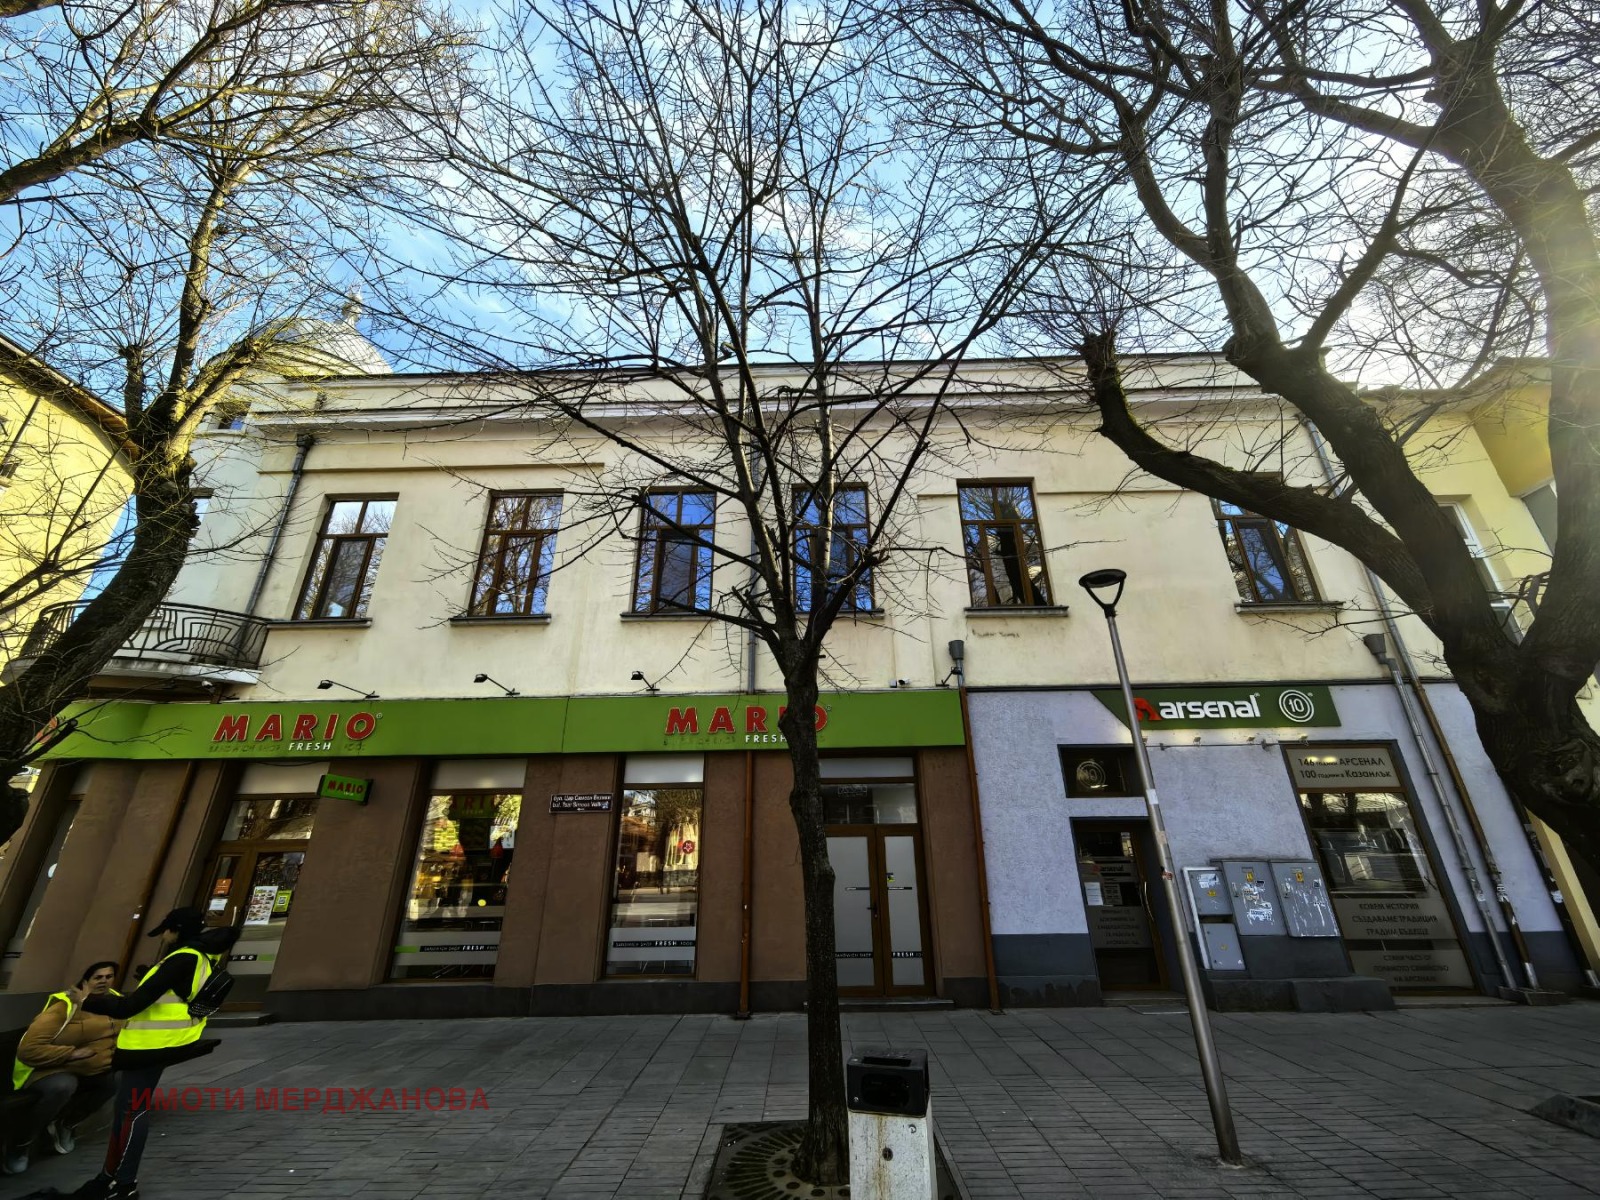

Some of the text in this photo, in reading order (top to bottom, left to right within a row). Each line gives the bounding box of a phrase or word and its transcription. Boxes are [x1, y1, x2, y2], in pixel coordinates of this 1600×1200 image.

[1159, 694, 1260, 719] arsenal
[1288, 698, 1305, 713] 10
[212, 711, 375, 741] MARIO
[745, 734, 788, 743] FRESH
[288, 742, 332, 751] FRESH
[1339, 757, 1386, 766] АРСЕНАЛ
[1300, 770, 1317, 779] 100
[1345, 769, 1393, 778] Казанлък
[327, 780, 364, 794] MARIO
